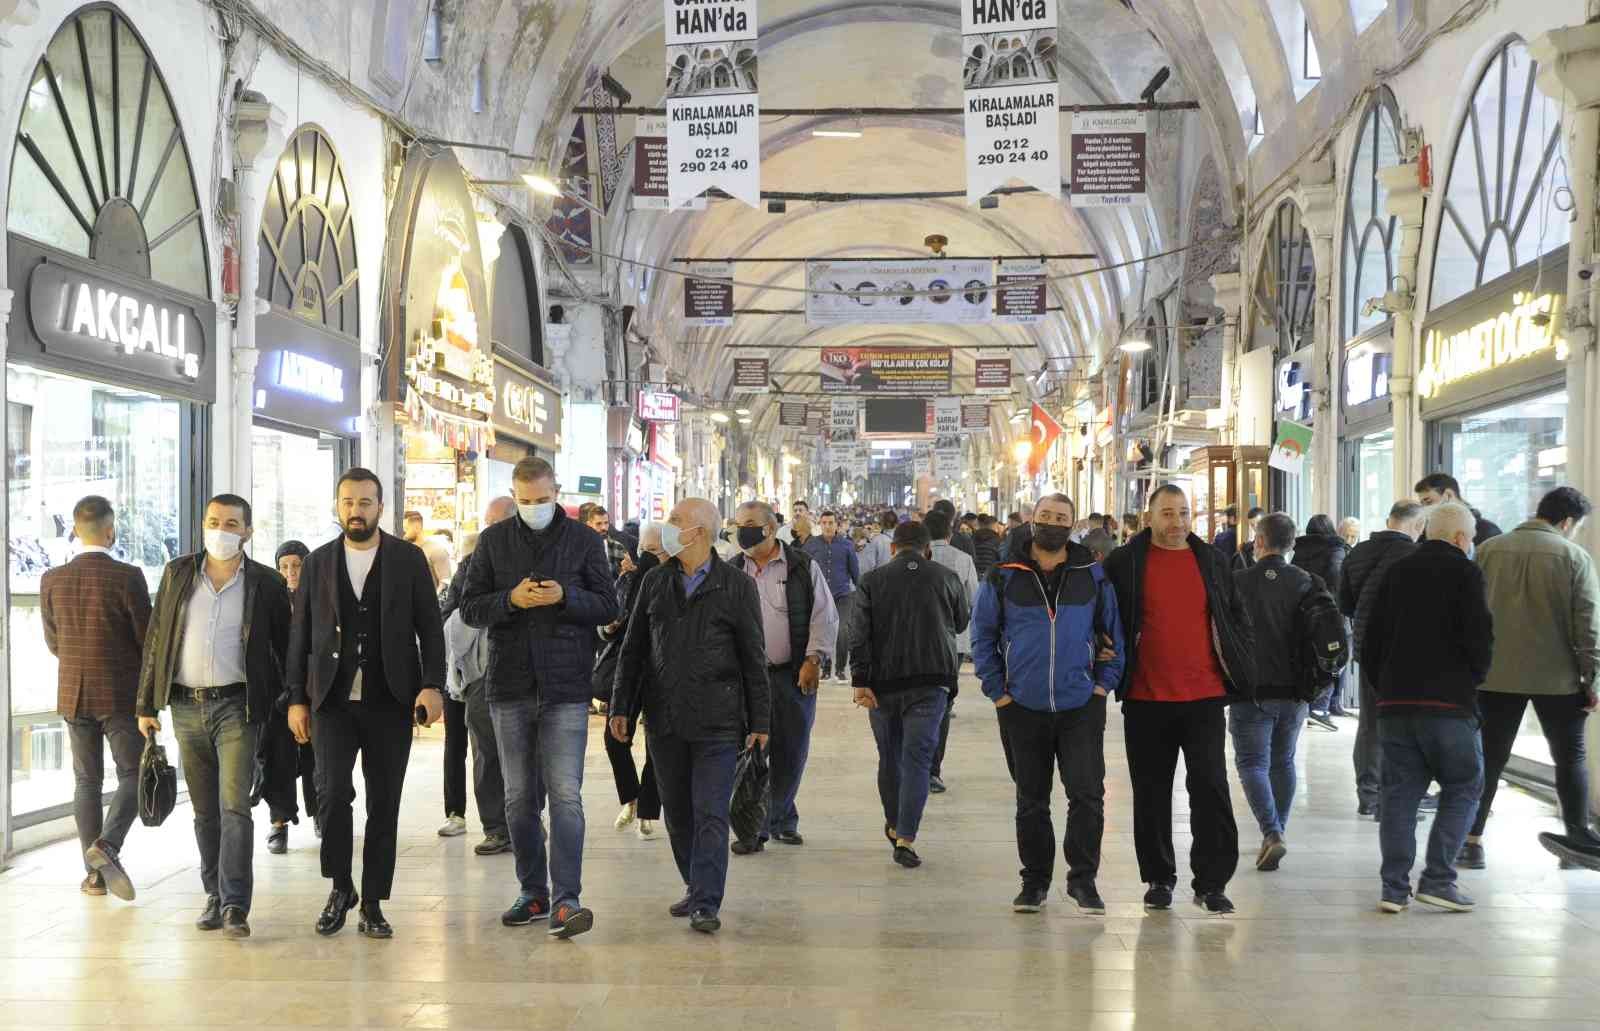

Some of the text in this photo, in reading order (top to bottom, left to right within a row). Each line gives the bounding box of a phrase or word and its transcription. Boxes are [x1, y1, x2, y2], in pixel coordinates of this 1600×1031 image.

[675, 6, 746, 35] HAN'da
[973, 0, 1046, 24] HAN'da
[970, 92, 1054, 113] KİRALAMALAR
[673, 103, 754, 122] KİRALAMALAR
[985, 111, 1037, 131] BAŞLADI
[688, 121, 738, 140] BAŞLADI
[695, 147, 730, 159] 0212
[993, 137, 1029, 151] 0212
[680, 161, 705, 173] 290
[710, 160, 727, 172] 24
[730, 159, 748, 171] 40
[978, 150, 1049, 166] 290 24 40
[73, 284, 185, 359] AKÇALI
